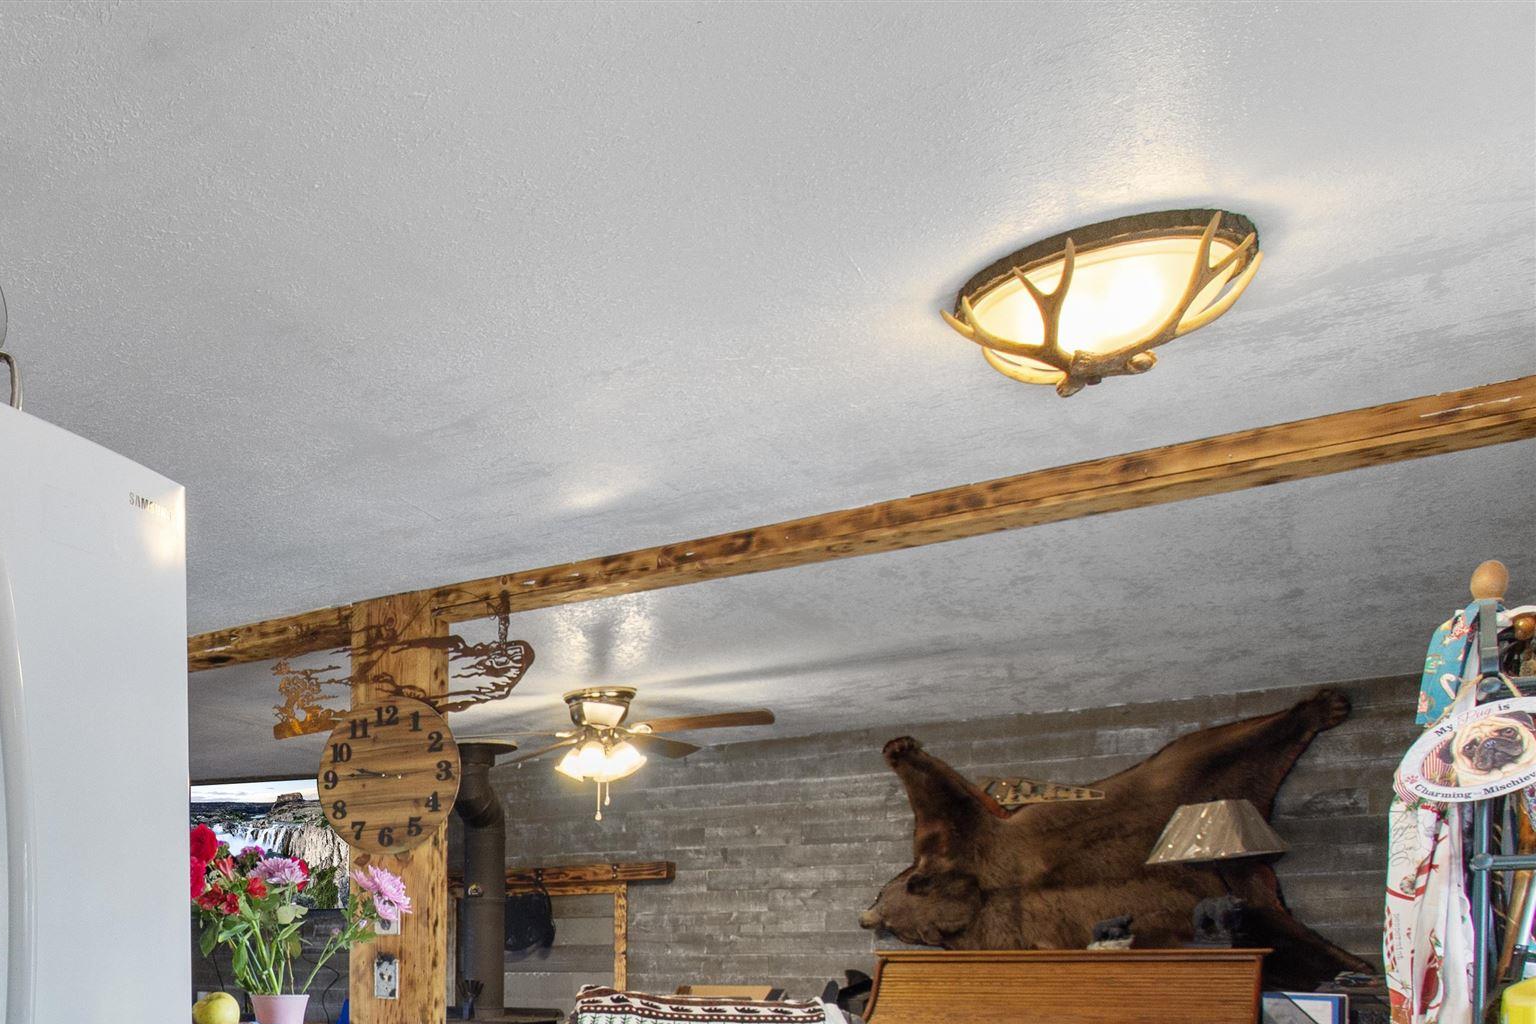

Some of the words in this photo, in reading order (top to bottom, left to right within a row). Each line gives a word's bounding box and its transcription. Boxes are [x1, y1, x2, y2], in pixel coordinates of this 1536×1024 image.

[374, 705, 399, 727] 12
[410, 711, 421, 731] 1
[1434, 722, 1454, 737] My
[1498, 702, 1511, 711] is
[349, 718, 370, 739] 11
[428, 732, 443, 752] 2
[331, 743, 352, 763] 10
[324, 770, 338, 789] 9
[436, 760, 452, 781] 3
[1414, 783, 1473, 800] Charming
[333, 800, 346, 819] 8
[425, 792, 441, 812] 4
[351, 821, 366, 840] 7
[407, 817, 422, 836] 5
[378, 827, 393, 847] 6
